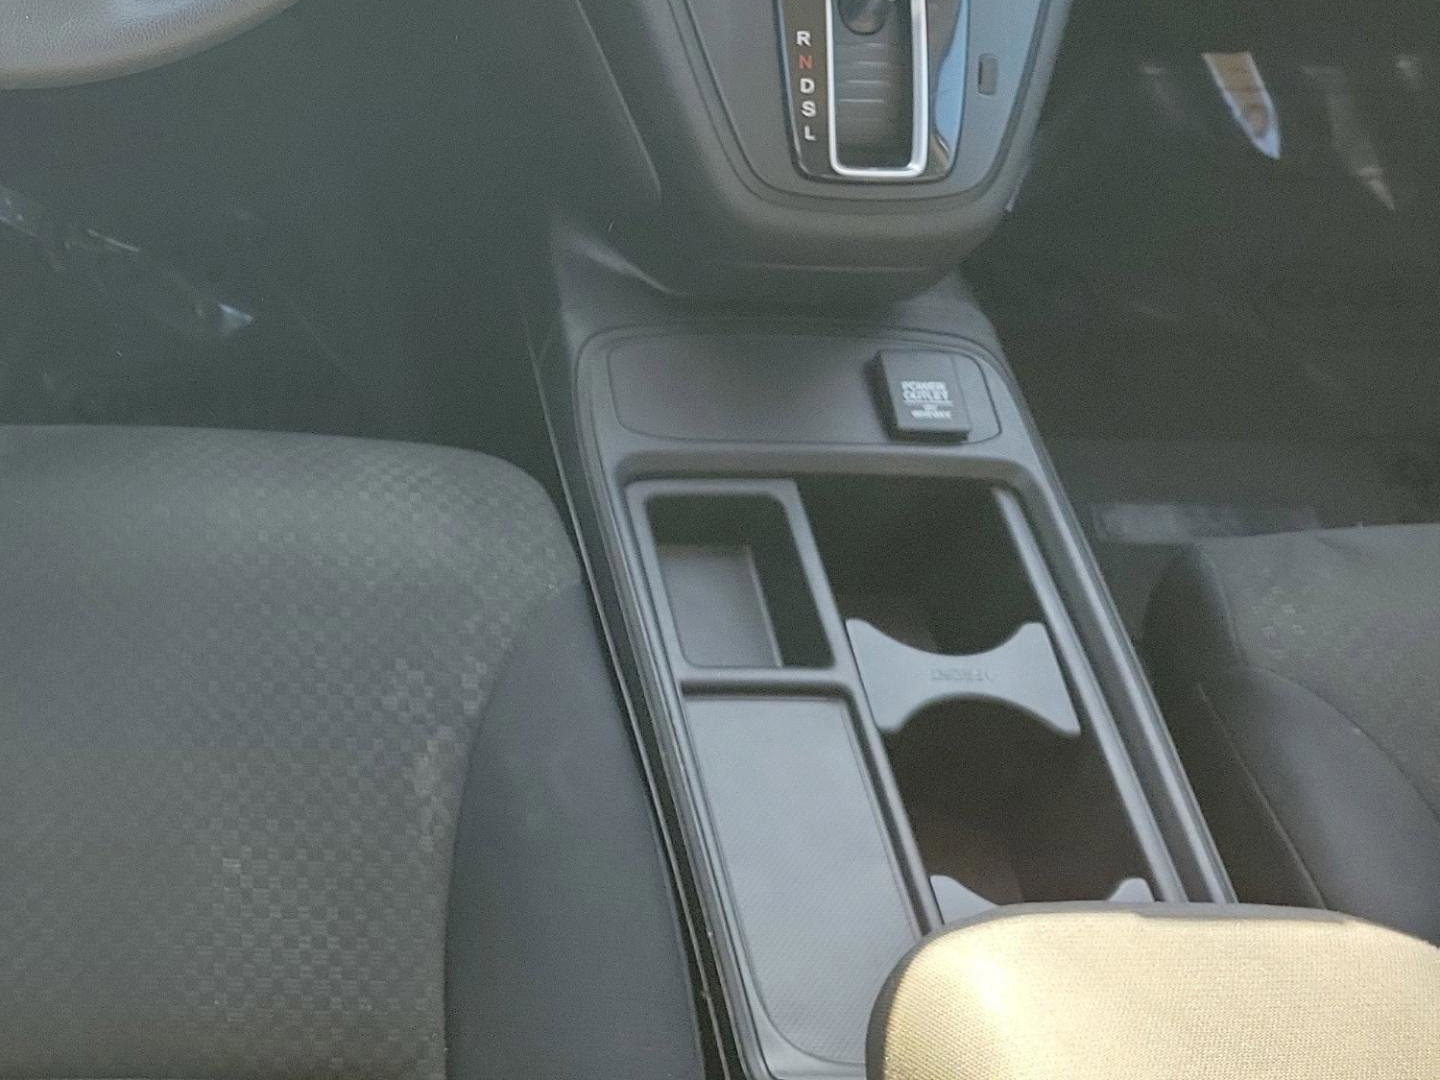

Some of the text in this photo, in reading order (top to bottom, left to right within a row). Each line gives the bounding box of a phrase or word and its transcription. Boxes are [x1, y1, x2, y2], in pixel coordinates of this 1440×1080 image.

[796, 30, 812, 46] R
[798, 55, 813, 69] N
[800, 78, 815, 93] D
[801, 101, 816, 118] S
[804, 127, 817, 141] L
